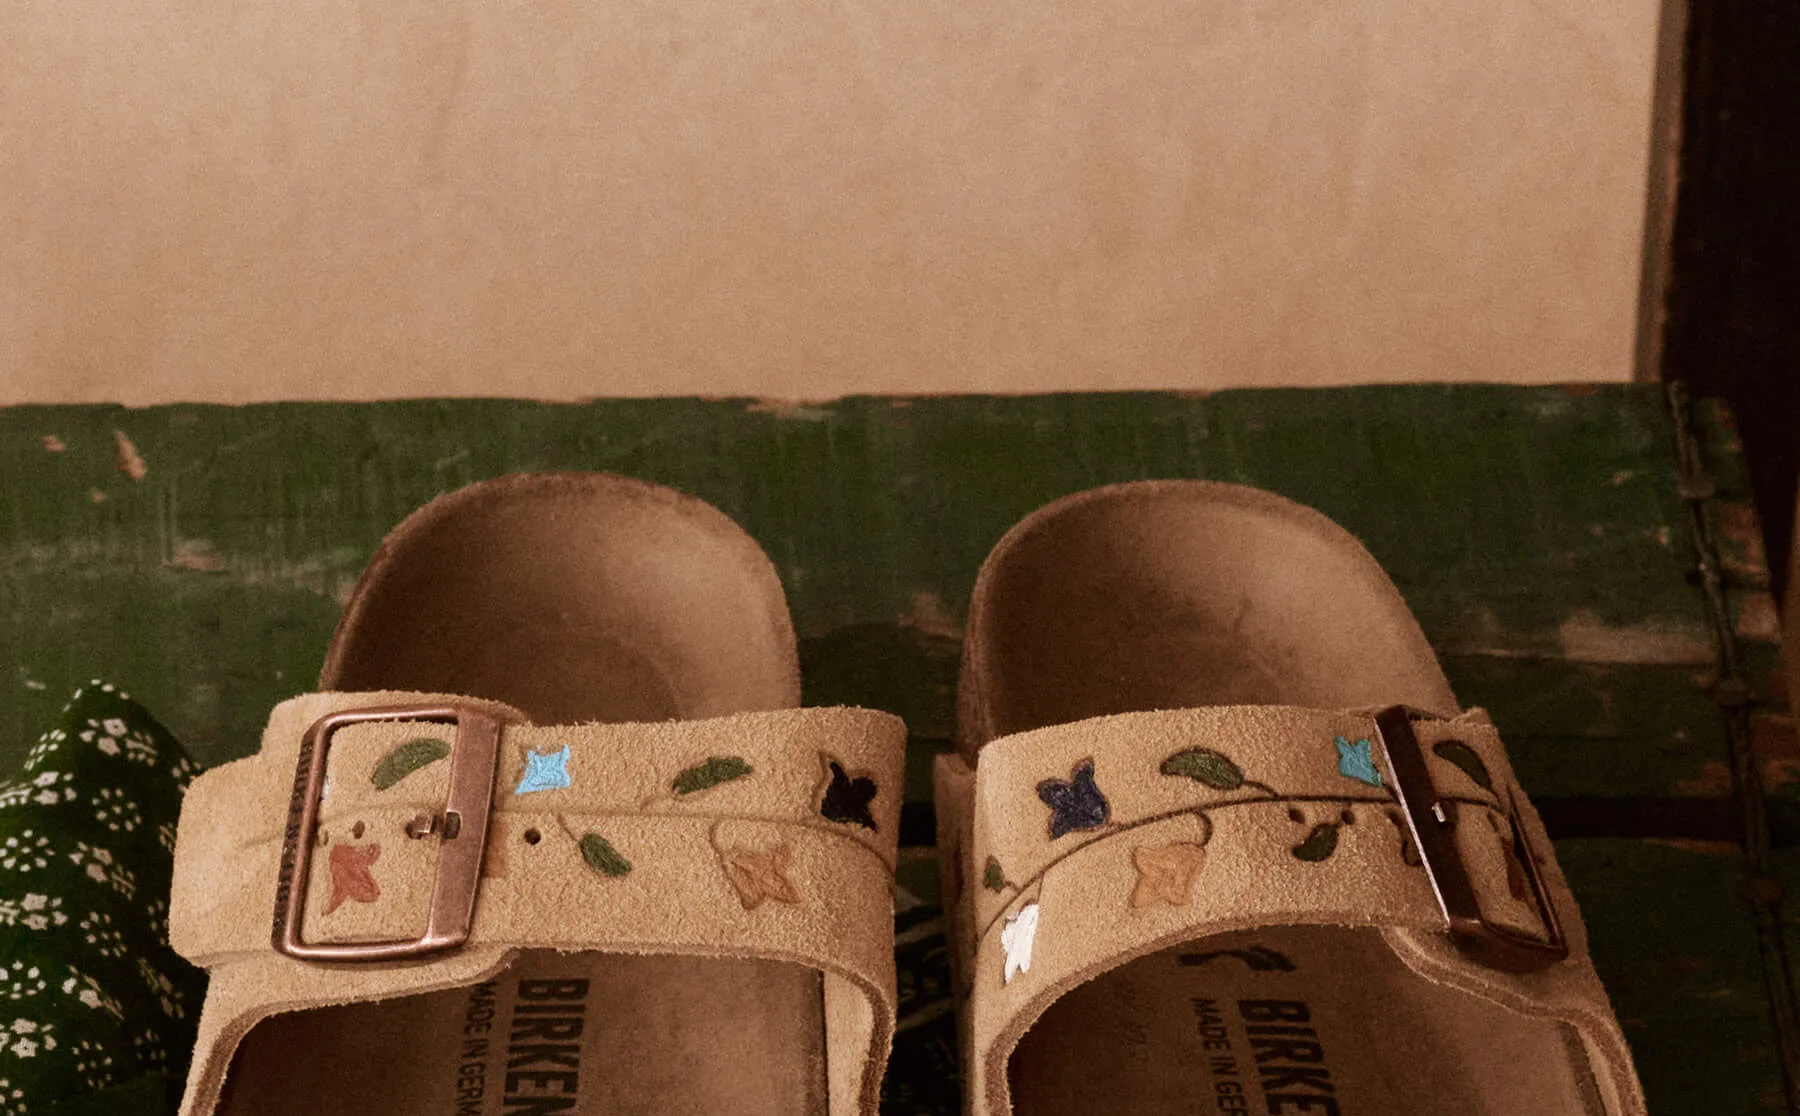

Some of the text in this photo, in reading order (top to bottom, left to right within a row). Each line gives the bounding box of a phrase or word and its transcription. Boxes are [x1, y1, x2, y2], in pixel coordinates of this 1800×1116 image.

[464, 981, 498, 1035] MADE
[1190, 998, 1231, 1051] MADE
[461, 1038, 489, 1059] IN
[1209, 1056, 1239, 1076] IN
